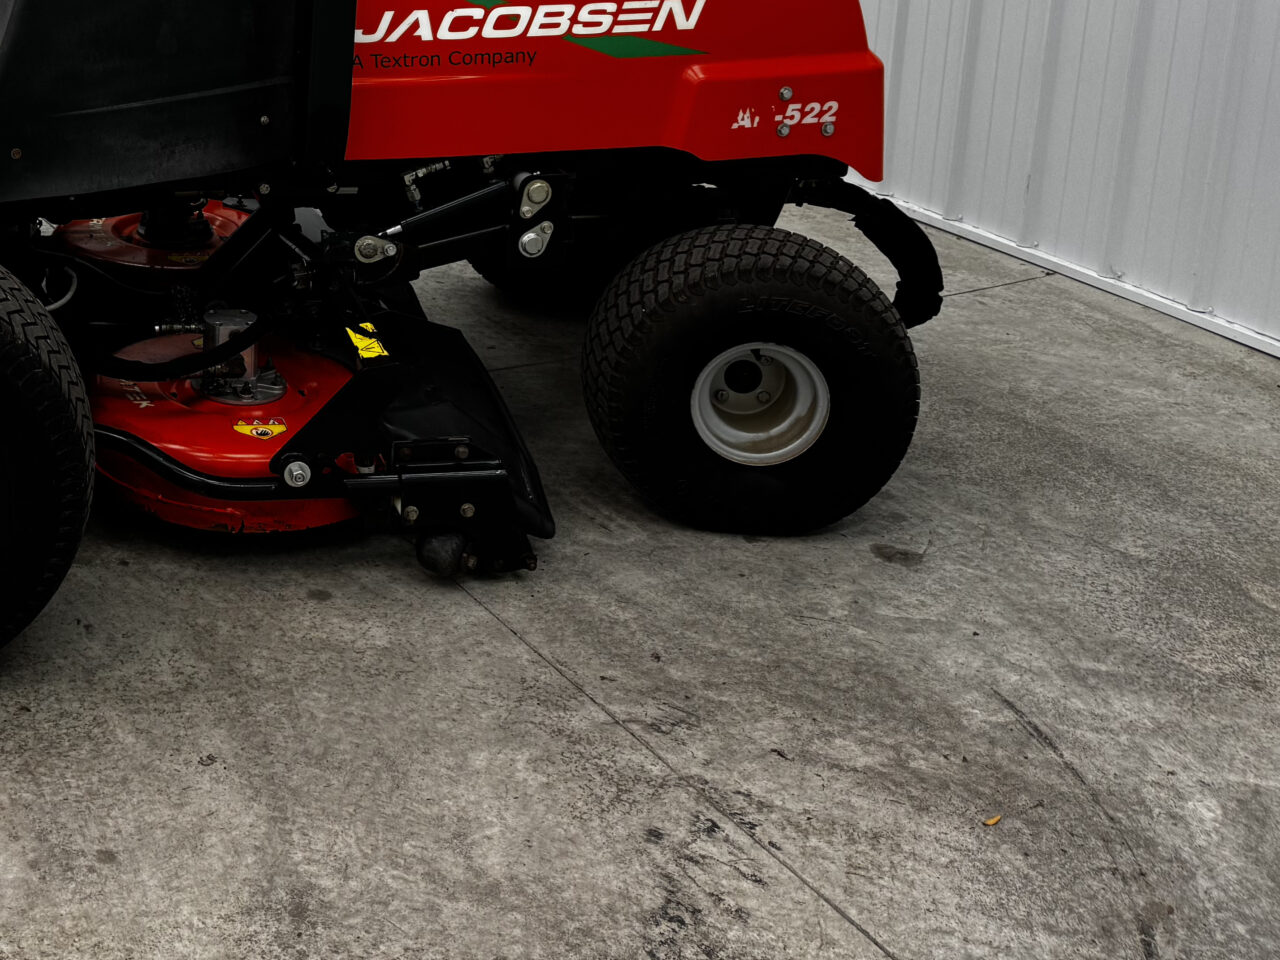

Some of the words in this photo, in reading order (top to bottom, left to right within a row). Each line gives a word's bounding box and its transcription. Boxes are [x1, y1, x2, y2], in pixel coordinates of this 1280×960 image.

[353, 55, 364, 69] A
[370, 53, 441, 69] Textron
[448, 50, 537, 67] Company
